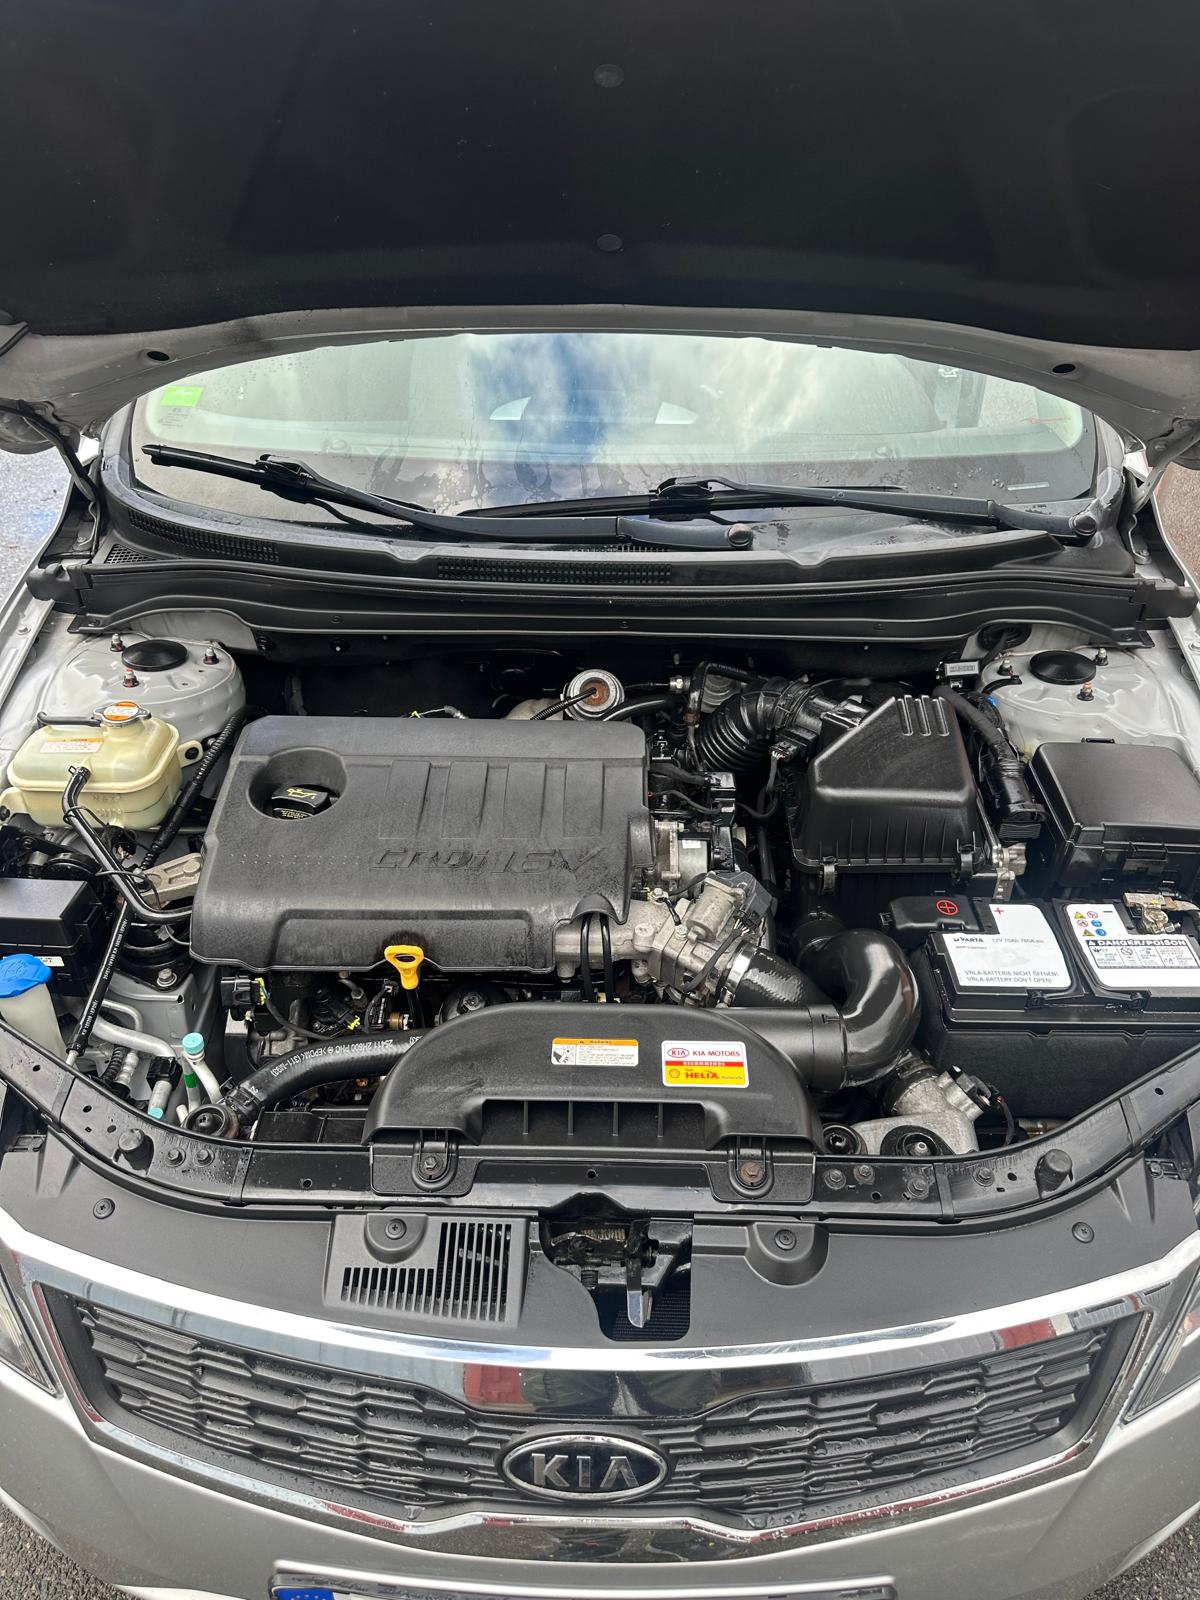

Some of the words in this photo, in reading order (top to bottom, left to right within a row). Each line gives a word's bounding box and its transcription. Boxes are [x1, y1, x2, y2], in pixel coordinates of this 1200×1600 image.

[707, 1050, 741, 1058] MOTORS
[685, 1070, 719, 1079] HELIX
[531, 1452, 640, 1489] KIA
